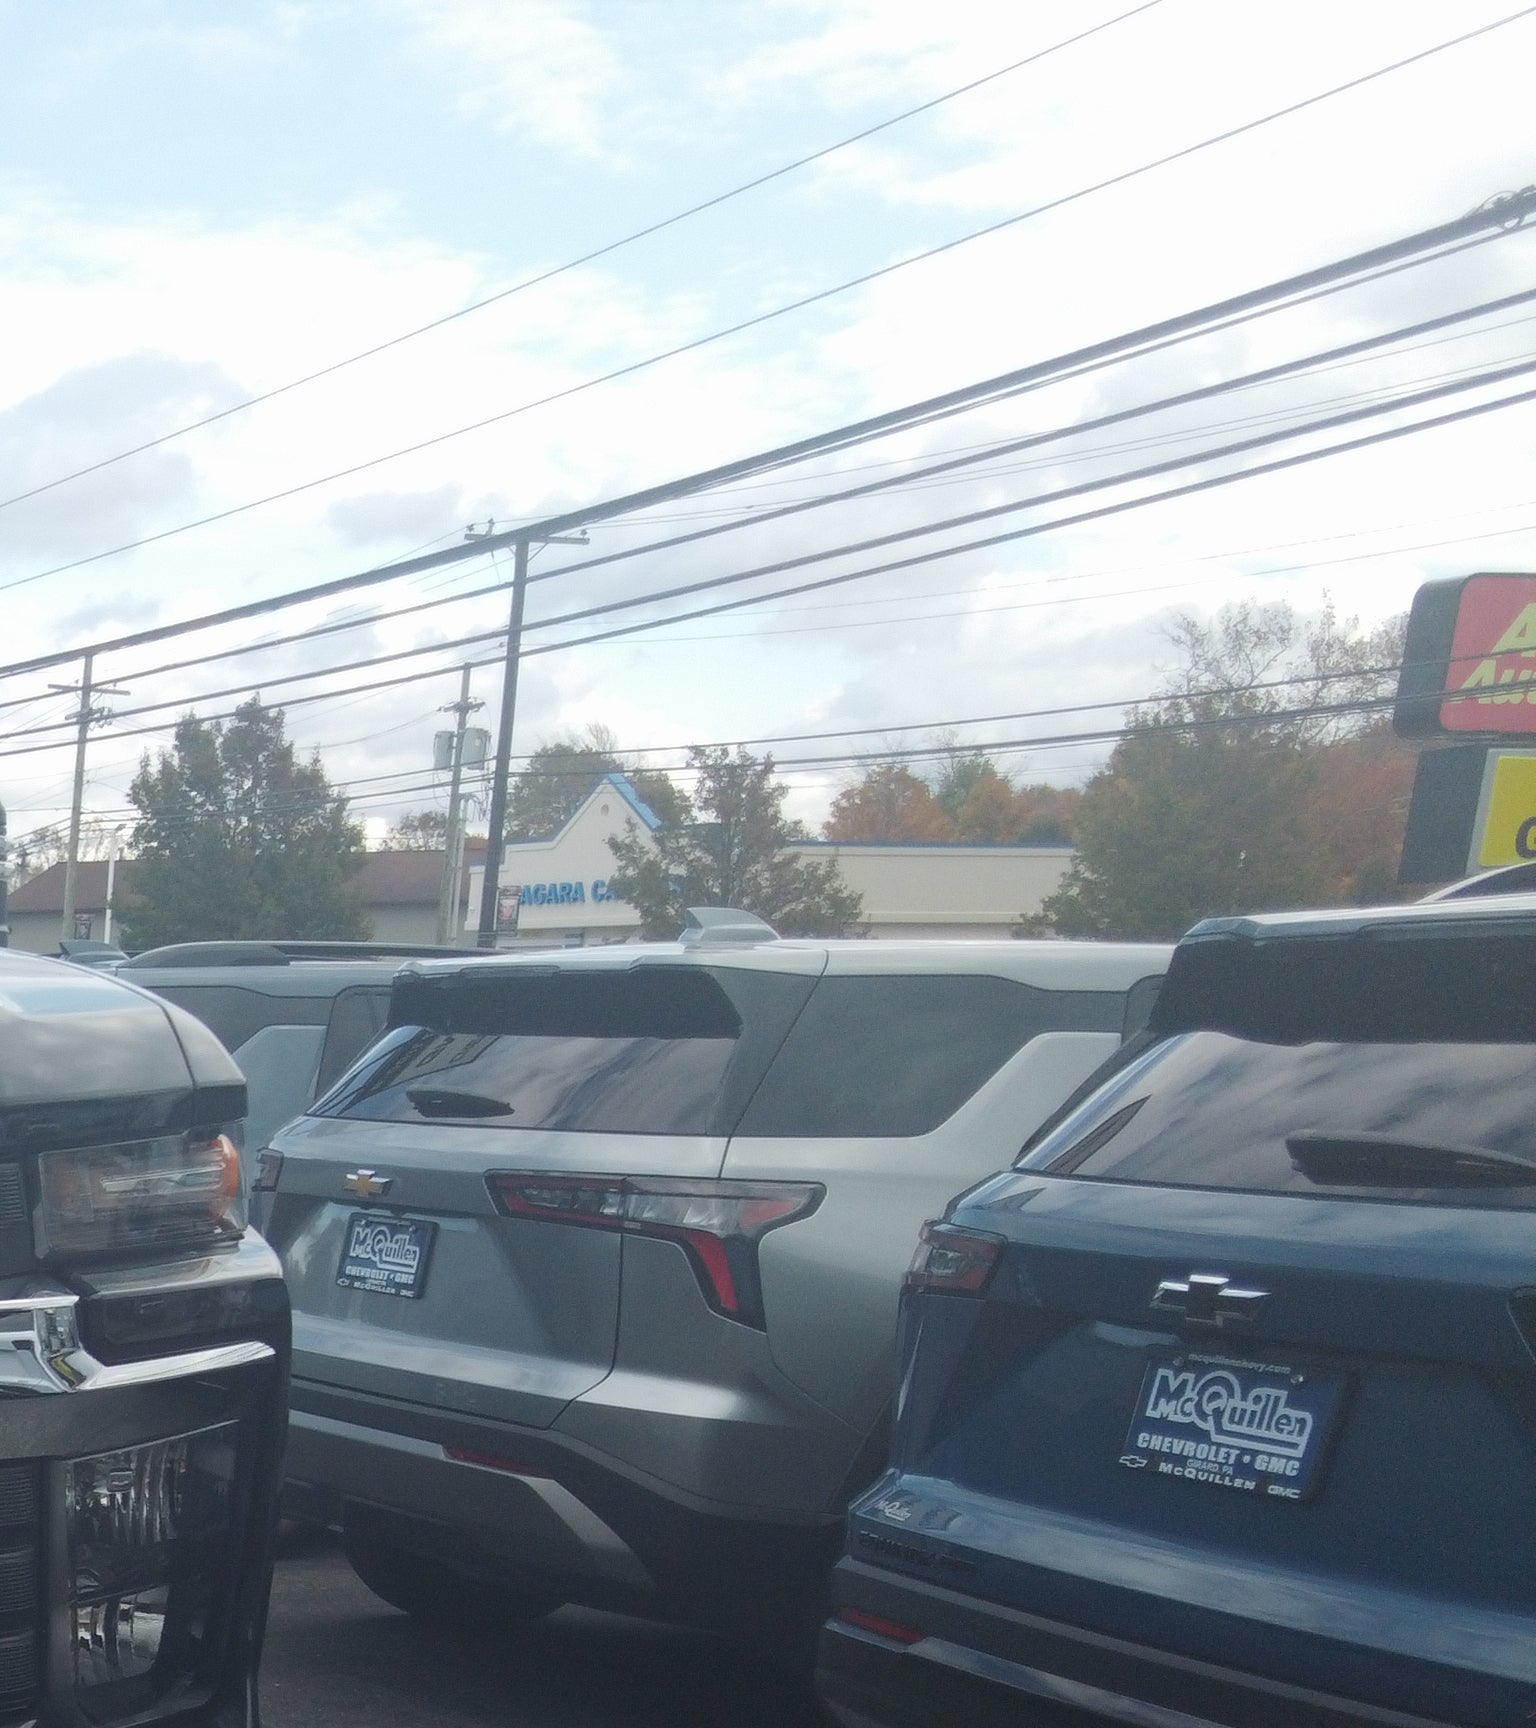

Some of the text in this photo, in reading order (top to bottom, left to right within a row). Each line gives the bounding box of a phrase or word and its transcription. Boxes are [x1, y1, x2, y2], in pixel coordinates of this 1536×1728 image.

[1448, 660, 1536, 704] Au
[520, 882, 586, 905] AGARA
[1145, 1367, 1313, 1459] McQuillen
[1137, 1432, 1301, 1476] CHEVROLET GMC
